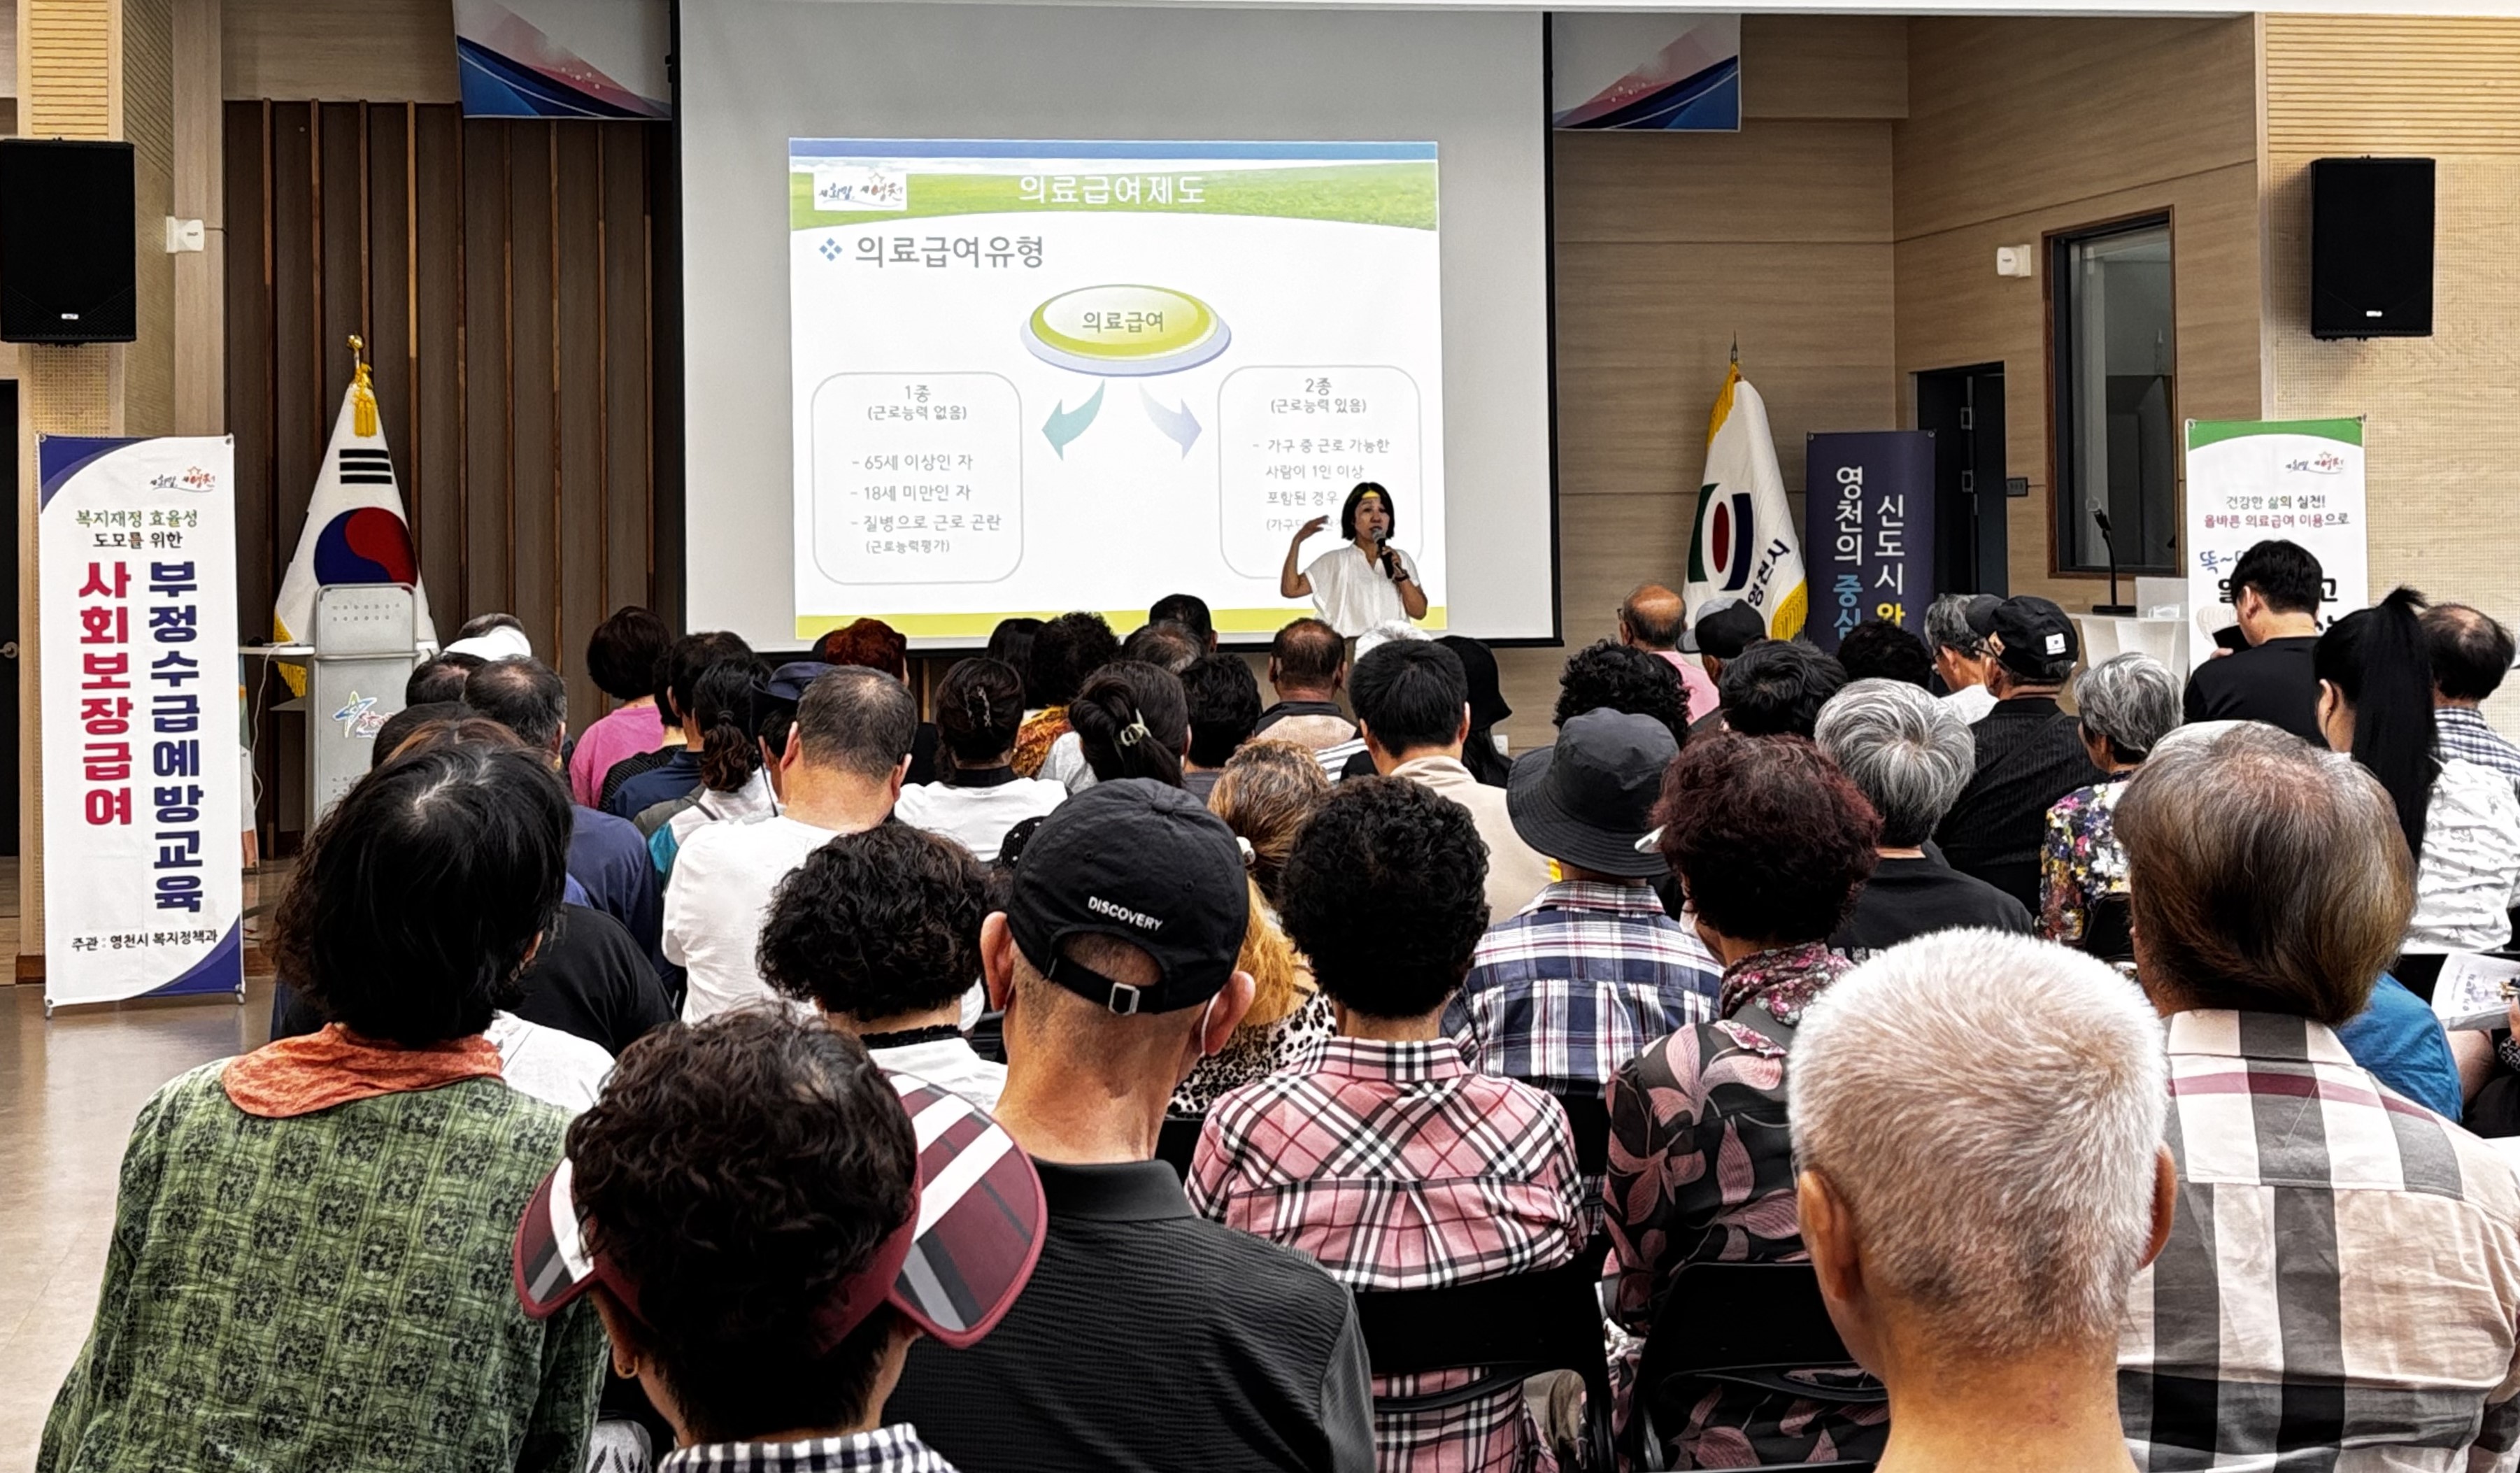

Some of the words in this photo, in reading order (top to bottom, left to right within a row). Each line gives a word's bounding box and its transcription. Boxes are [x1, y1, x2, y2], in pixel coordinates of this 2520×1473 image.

[1019, 175, 1206, 205] 의료급여제도
[855, 236, 1043, 269] 의료급여유형
[1082, 311, 1164, 334] 의료급여
[905, 385, 931, 404] 1종
[1305, 378, 1332, 396] 2종
[867, 406, 928, 421] (근로능력
[934, 406, 967, 420] 없음)
[1271, 399, 1330, 413] (근로능력
[1334, 398, 1367, 413] 있음)
[1268, 439, 1295, 453] 가구
[1300, 439, 1314, 453] 중
[1317, 439, 1345, 453] 근로
[1349, 438, 1390, 454] 가능한
[864, 455, 899, 471] 65세
[904, 454, 951, 471] 이상인
[958, 454, 974, 471] 자
[1266, 464, 1306, 480] 사람이
[1312, 464, 1332, 479] 1인
[1337, 464, 1365, 479] 이상
[864, 485, 896, 501] 18세
[903, 485, 949, 501] 미만인
[955, 485, 971, 501] 자
[1312, 491, 1339, 506] 경우
[2226, 496, 2263, 510] 건강한
[76, 510, 143, 528] 복지재정
[149, 509, 198, 528] 효율성
[864, 515, 928, 533] 질병으로
[933, 515, 965, 532] 근로
[970, 514, 1002, 531] 곤란
[1834, 466, 1863, 566] 영천의
[2204, 514, 2241, 529] 올바른
[2245, 514, 2295, 529] 의료급여
[2299, 513, 2351, 529] 이용으로
[93, 532, 144, 549] 도모를
[150, 532, 183, 548] 위한
[866, 539, 950, 554] (근로능력평가)
[1874, 494, 1905, 596] 신도시
[1748, 538, 1791, 607] 영천시
[78, 561, 134, 825] 사회보장급여
[1088, 896, 1163, 930] DISCOVERY
[71, 937, 99, 952] 주관
[110, 934, 149, 949] 영천시
[152, 929, 218, 946] 복지정책과
